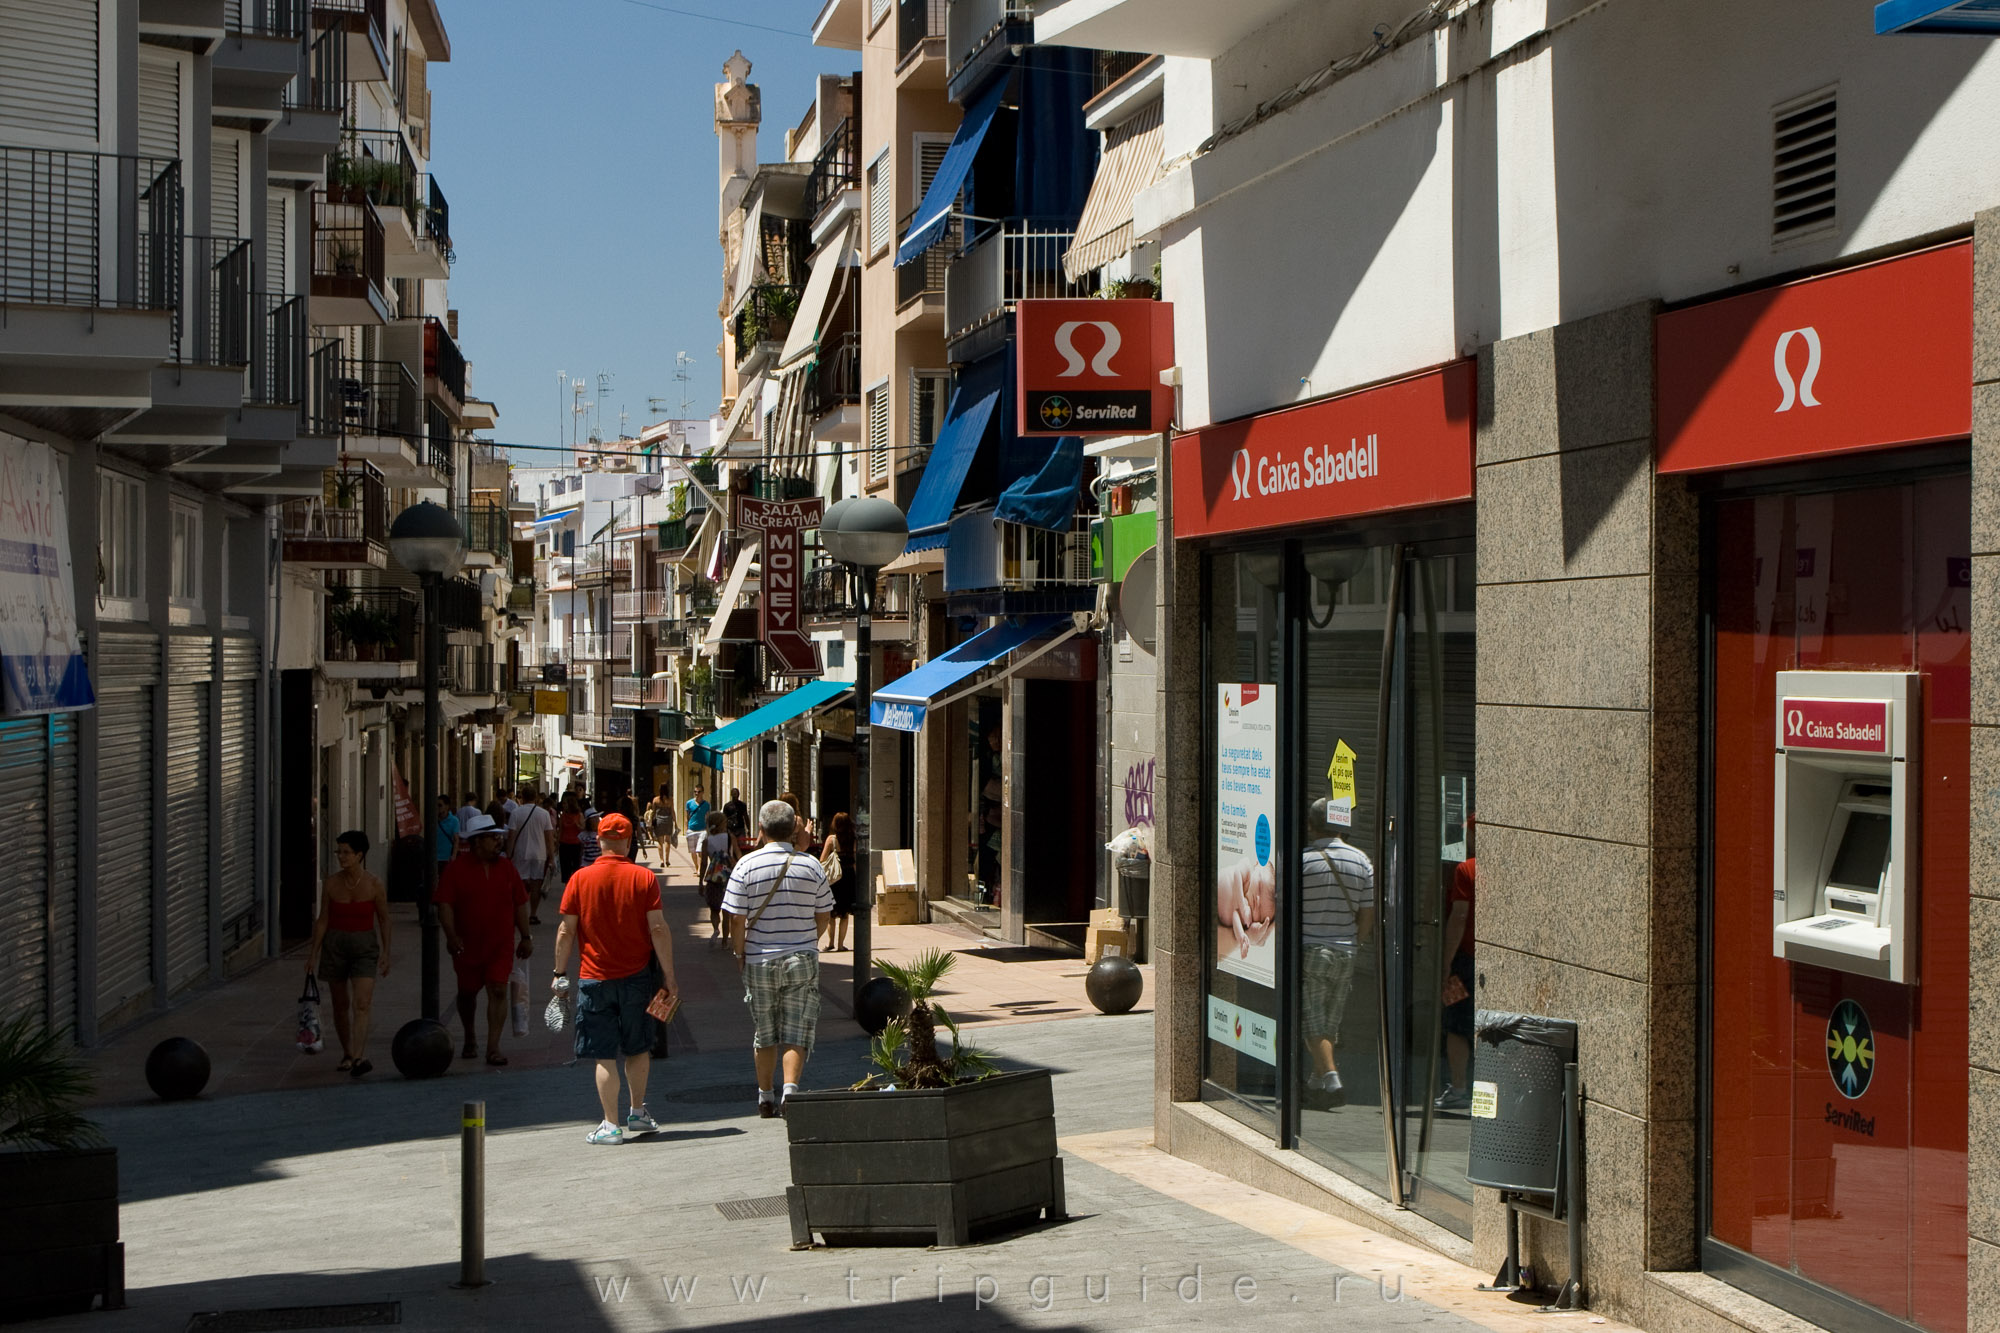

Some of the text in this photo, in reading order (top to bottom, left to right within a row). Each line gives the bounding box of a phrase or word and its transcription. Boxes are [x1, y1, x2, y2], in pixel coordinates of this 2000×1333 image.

[1075, 404, 1137, 420] ServiRed
[1257, 433, 1378, 496] Caixa Sabadell
[743, 507, 820, 528] RECREATIVA
[761, 503, 803, 516] SALA
[770, 534, 793, 627] MONEY
[1806, 720, 1881, 742] Caixa Sabadell
[1221, 744, 1263, 762] La seguretat dels
[1335, 753, 1348, 764] tenim
[1221, 761, 1271, 779] teus sempre ha estat
[1332, 766, 1337, 776] el
[1344, 769, 1353, 780] que
[1225, 777, 1233, 791] les
[1247, 783, 1262, 795] mans.
[1334, 780, 1351, 793] busques
[1221, 801, 1230, 816] Ara
[1213, 1006, 1267, 1040] Unnim Unnim
[1824, 1101, 1876, 1137] ServiRed
